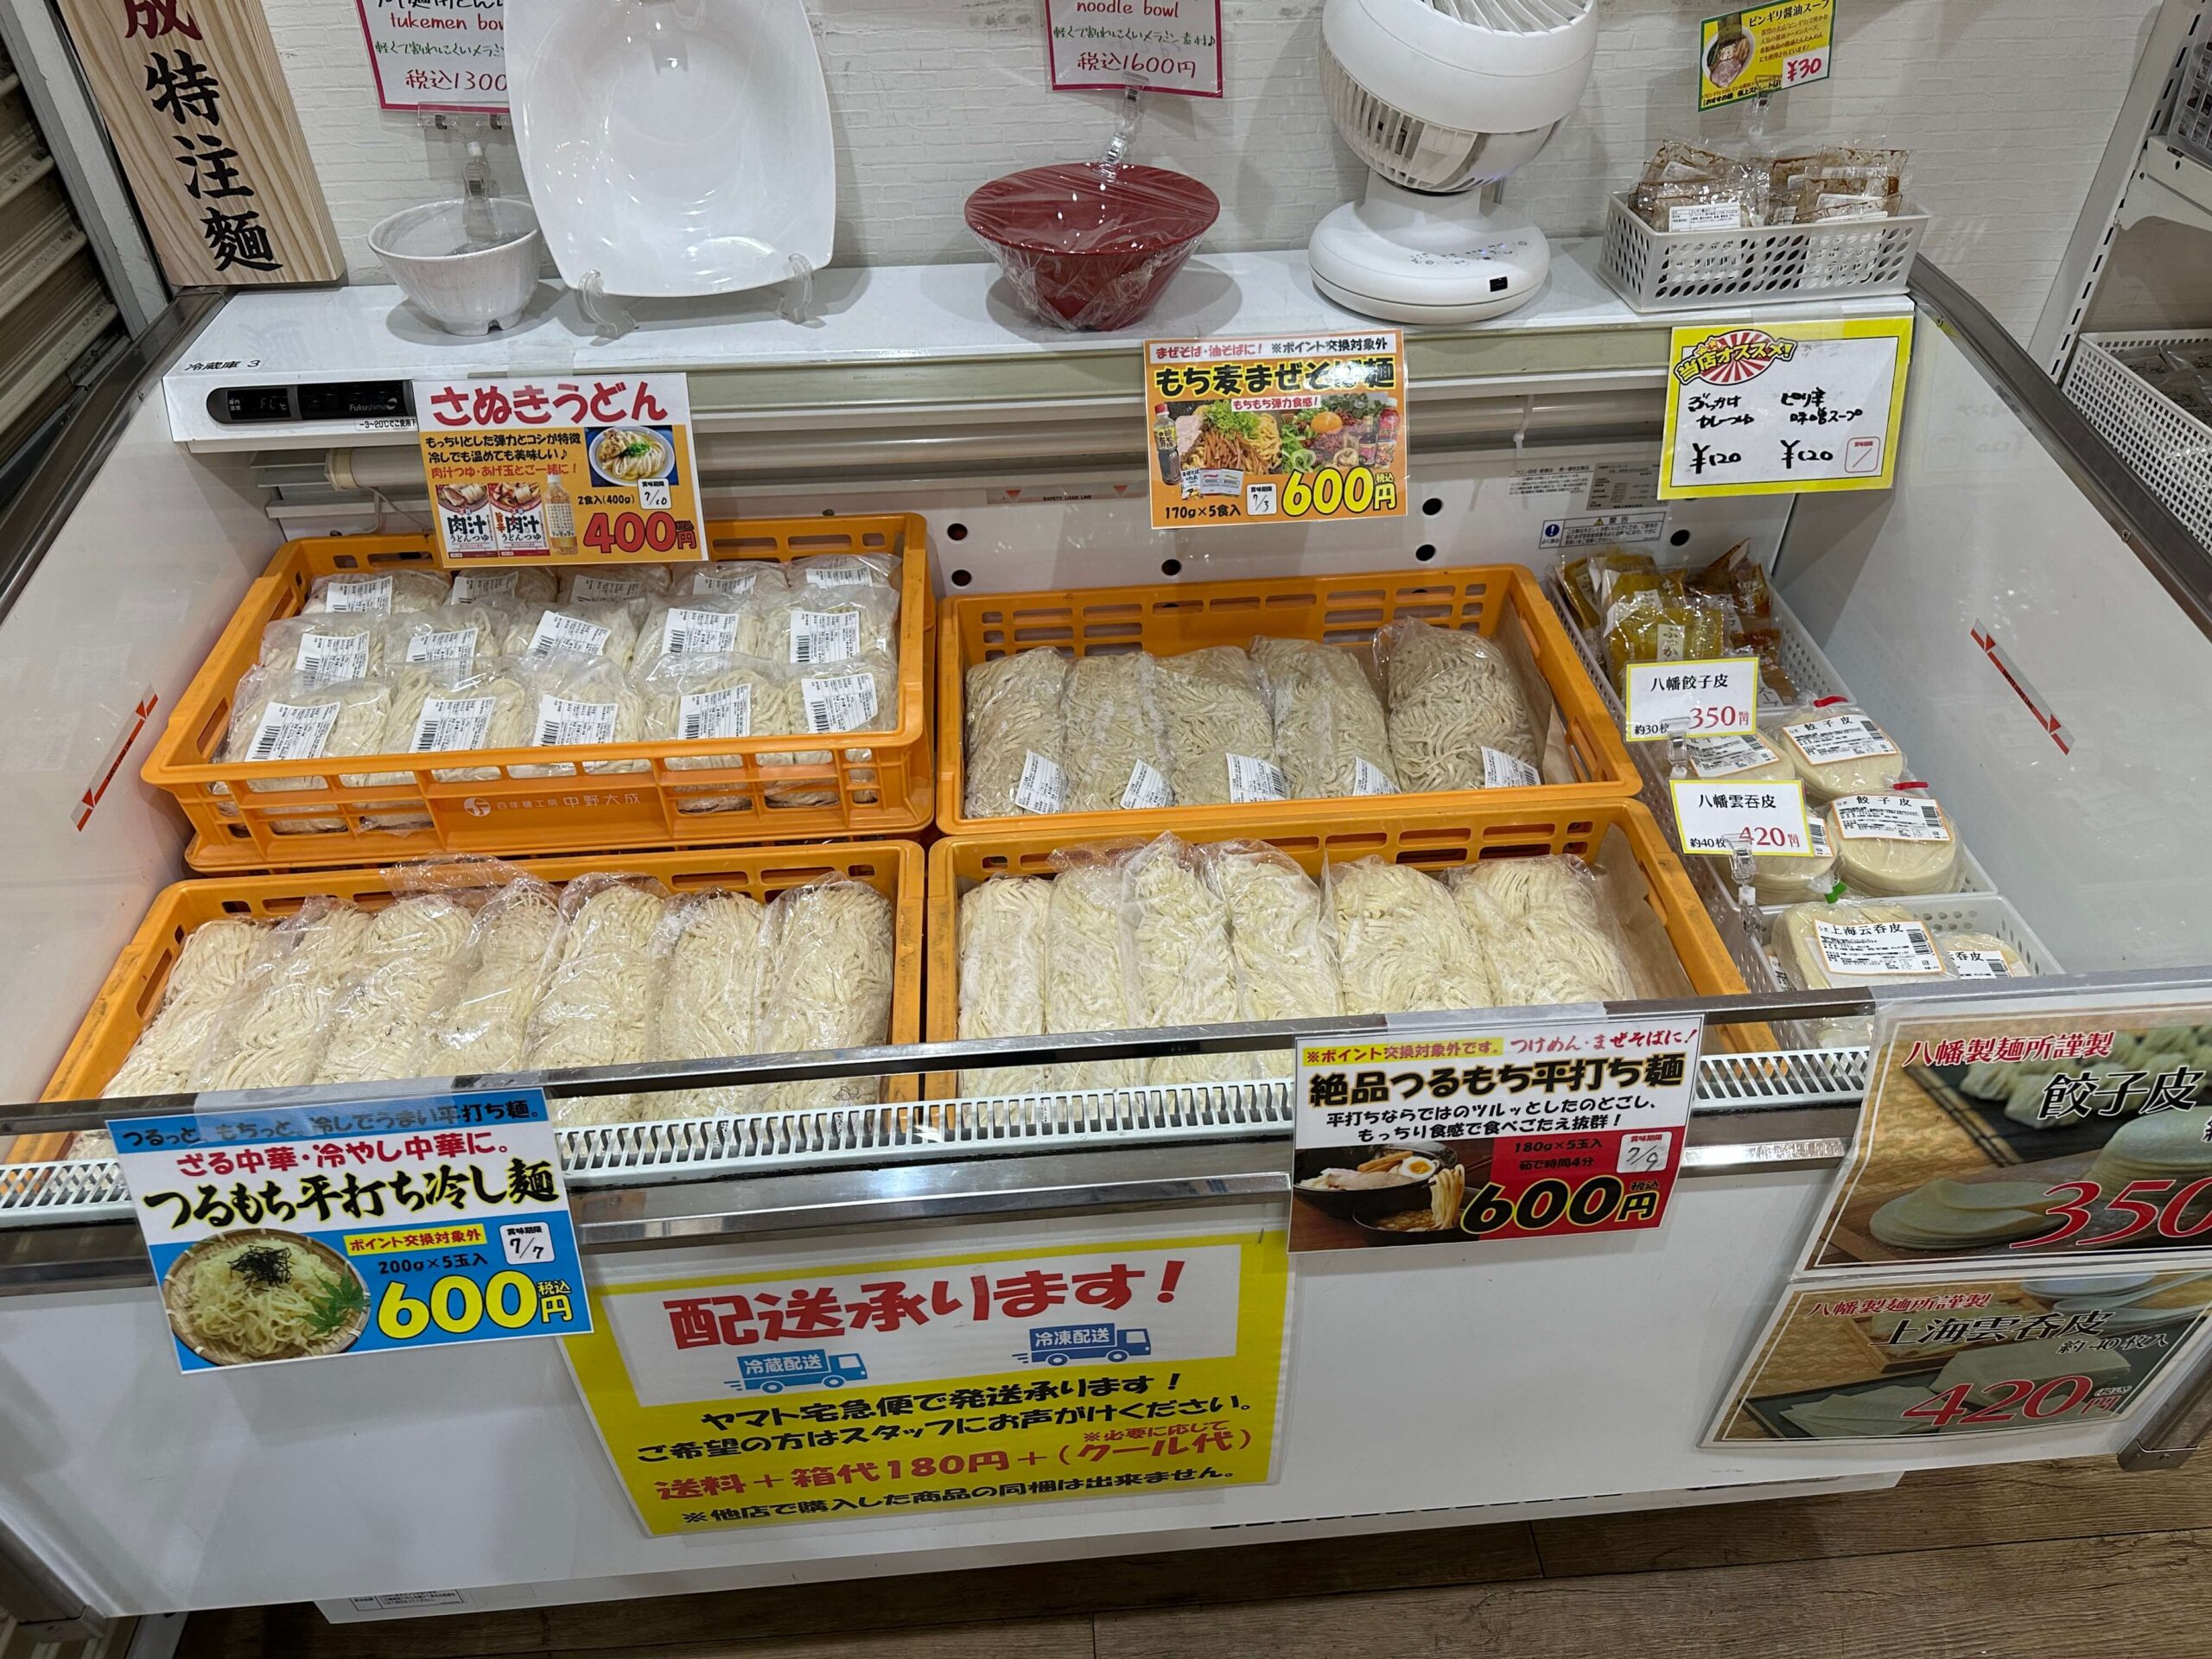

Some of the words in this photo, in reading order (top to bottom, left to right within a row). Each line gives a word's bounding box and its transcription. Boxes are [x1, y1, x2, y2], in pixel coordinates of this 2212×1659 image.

[390, 10, 467, 29] tukemen
[1077, 0, 1133, 14] noodle
[1144, 0, 1179, 18] bowl
[1077, 52, 1196, 79] 税込1600円
[1787, 57, 1822, 82] ¥30
[184, 360, 240, 372] 冷蔵庫
[247, 359, 261, 368] 3
[430, 382, 668, 426] さぬきうどん
[425, 433, 582, 448] もっちりとした弾力とコシが特徴
[1689, 442, 1742, 474] ¥120
[1780, 439, 1834, 469] ¥120
[447, 514, 486, 535] 肉汁
[505, 514, 540, 534] 肉汁
[450, 533, 490, 542] うどんつゆ
[502, 533, 542, 542] うどんつゆ
[1650, 673, 1728, 692] 八幡餃子皮
[563, 792, 641, 808] 中野大成
[1689, 837, 1726, 849] 約40枚
[1902, 1030, 2115, 1067] 八幡製麺所謹製
[1308, 1052, 1685, 1108] 絶品つるもち平打ち麺
[2037, 1065, 2206, 1121] 餃子皮
[1630, 1180, 1660, 1192] 税込
[2009, 1176, 2212, 1249] 350
[349, 1227, 484, 1254] ポイント交換対象外
[506, 1225, 543, 1236] 賞味期限
[537, 1280, 572, 1296] 税込
[1803, 1292, 1993, 1319] 八幡製麺所謹製
[1033, 1325, 1110, 1348] 冷凍配送
[1868, 1308, 2116, 1347] 上海雲呑皮
[744, 1353, 824, 1376] 冷蔵配送
[637, 1394, 1250, 1463] ご希望の方はスタッフにお声がけください。
